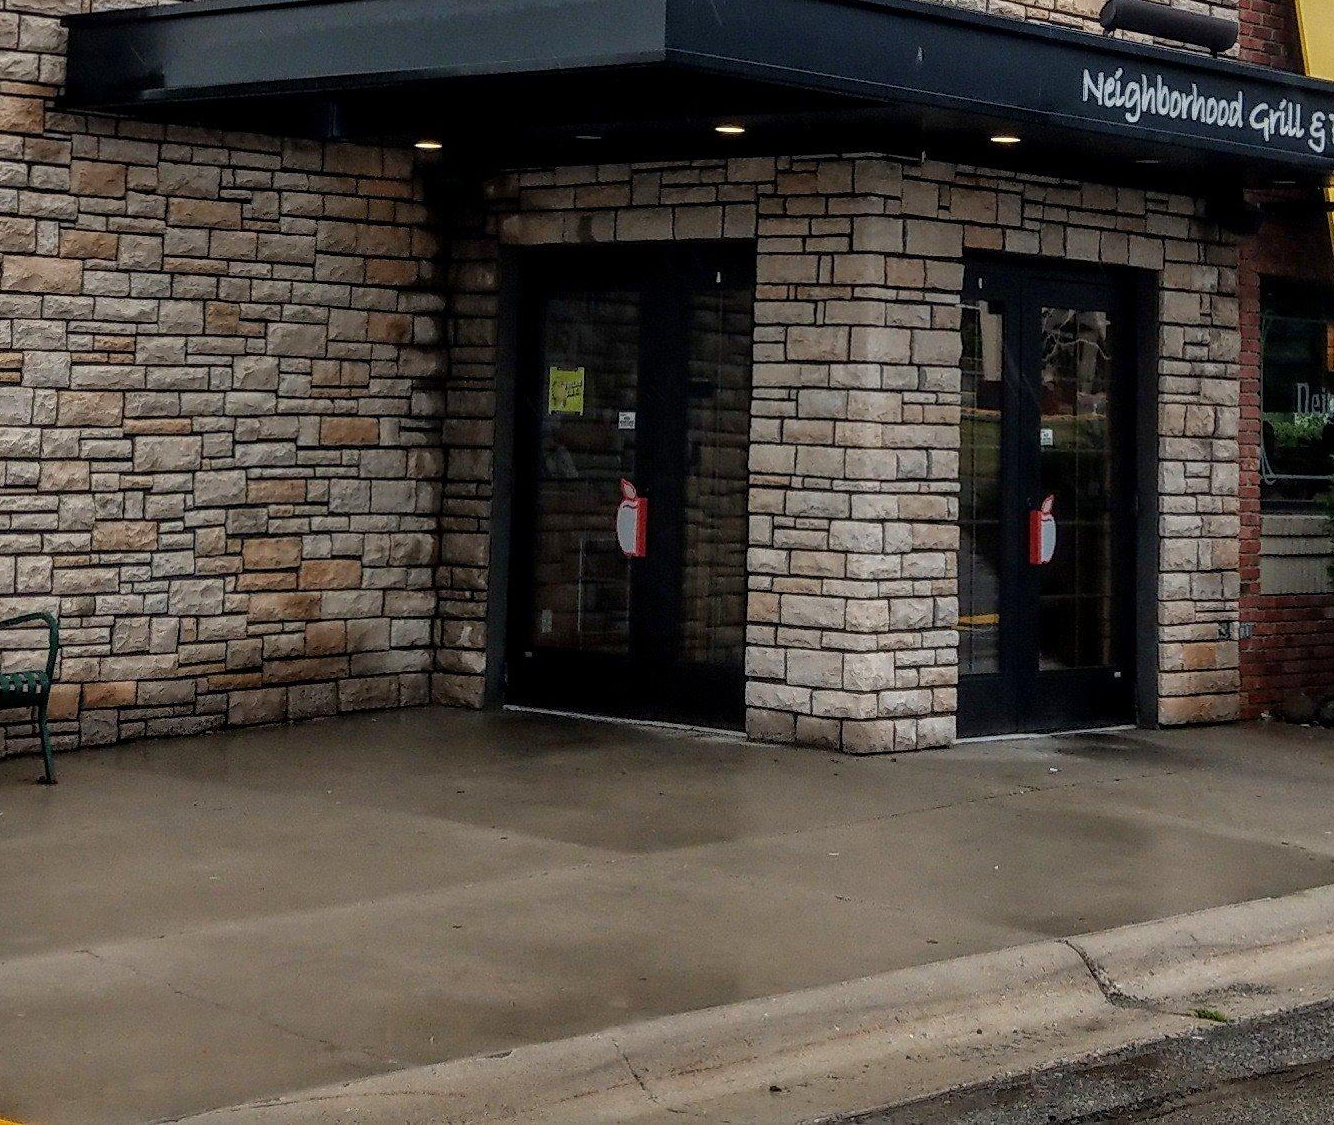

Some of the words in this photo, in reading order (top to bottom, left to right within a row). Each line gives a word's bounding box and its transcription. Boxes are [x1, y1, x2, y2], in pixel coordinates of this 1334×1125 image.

[1082, 67, 1244, 128] Neighborhood
[1248, 97, 1305, 142] Grill
[1307, 111, 1326, 154] &
